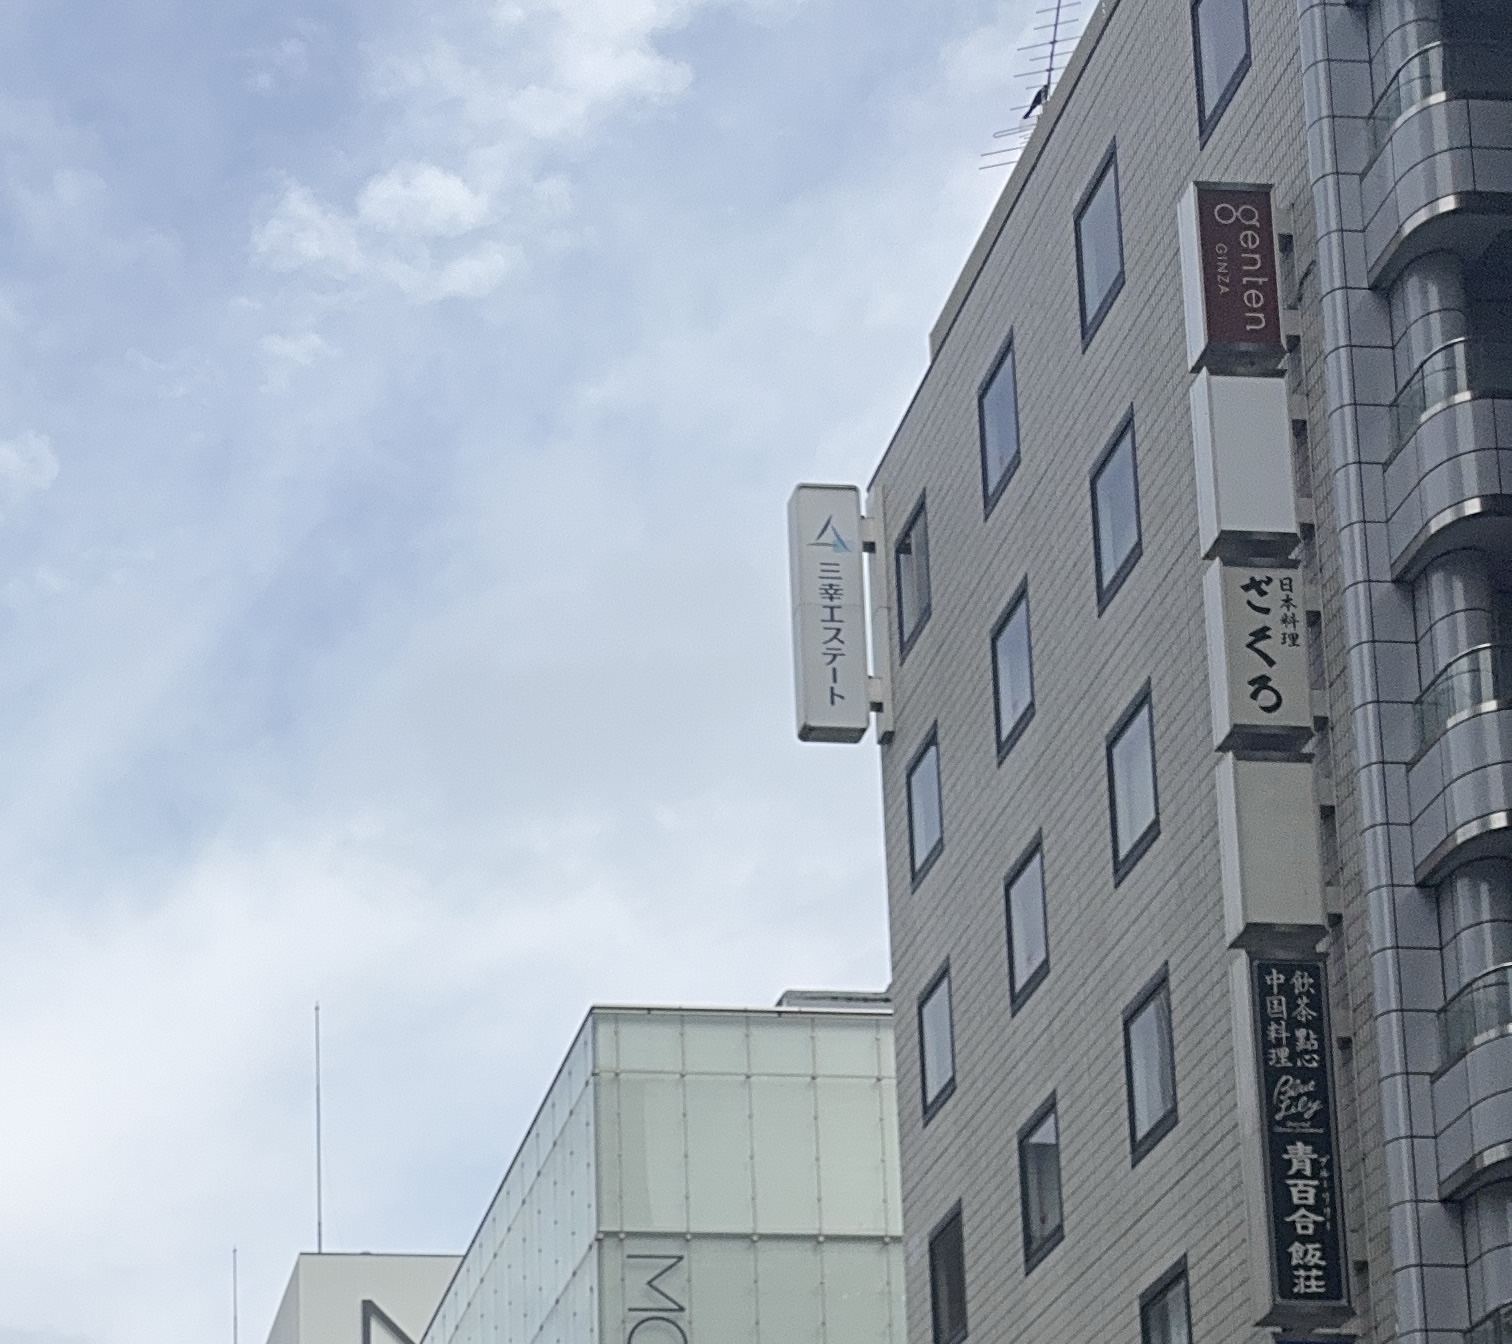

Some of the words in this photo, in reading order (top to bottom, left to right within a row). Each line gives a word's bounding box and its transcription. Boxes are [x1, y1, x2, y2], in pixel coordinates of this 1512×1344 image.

[1214, 203, 1269, 331] genten
[1215, 243, 1230, 294] GINZA
[818, 562, 846, 706] 三幸エステート
[1240, 575, 1283, 714] ざくろ
[1279, 576, 1300, 648] 日本料理
[1264, 968, 1294, 1068] 中国料理
[1281, 1141, 1328, 1294] 青百合飯荘
